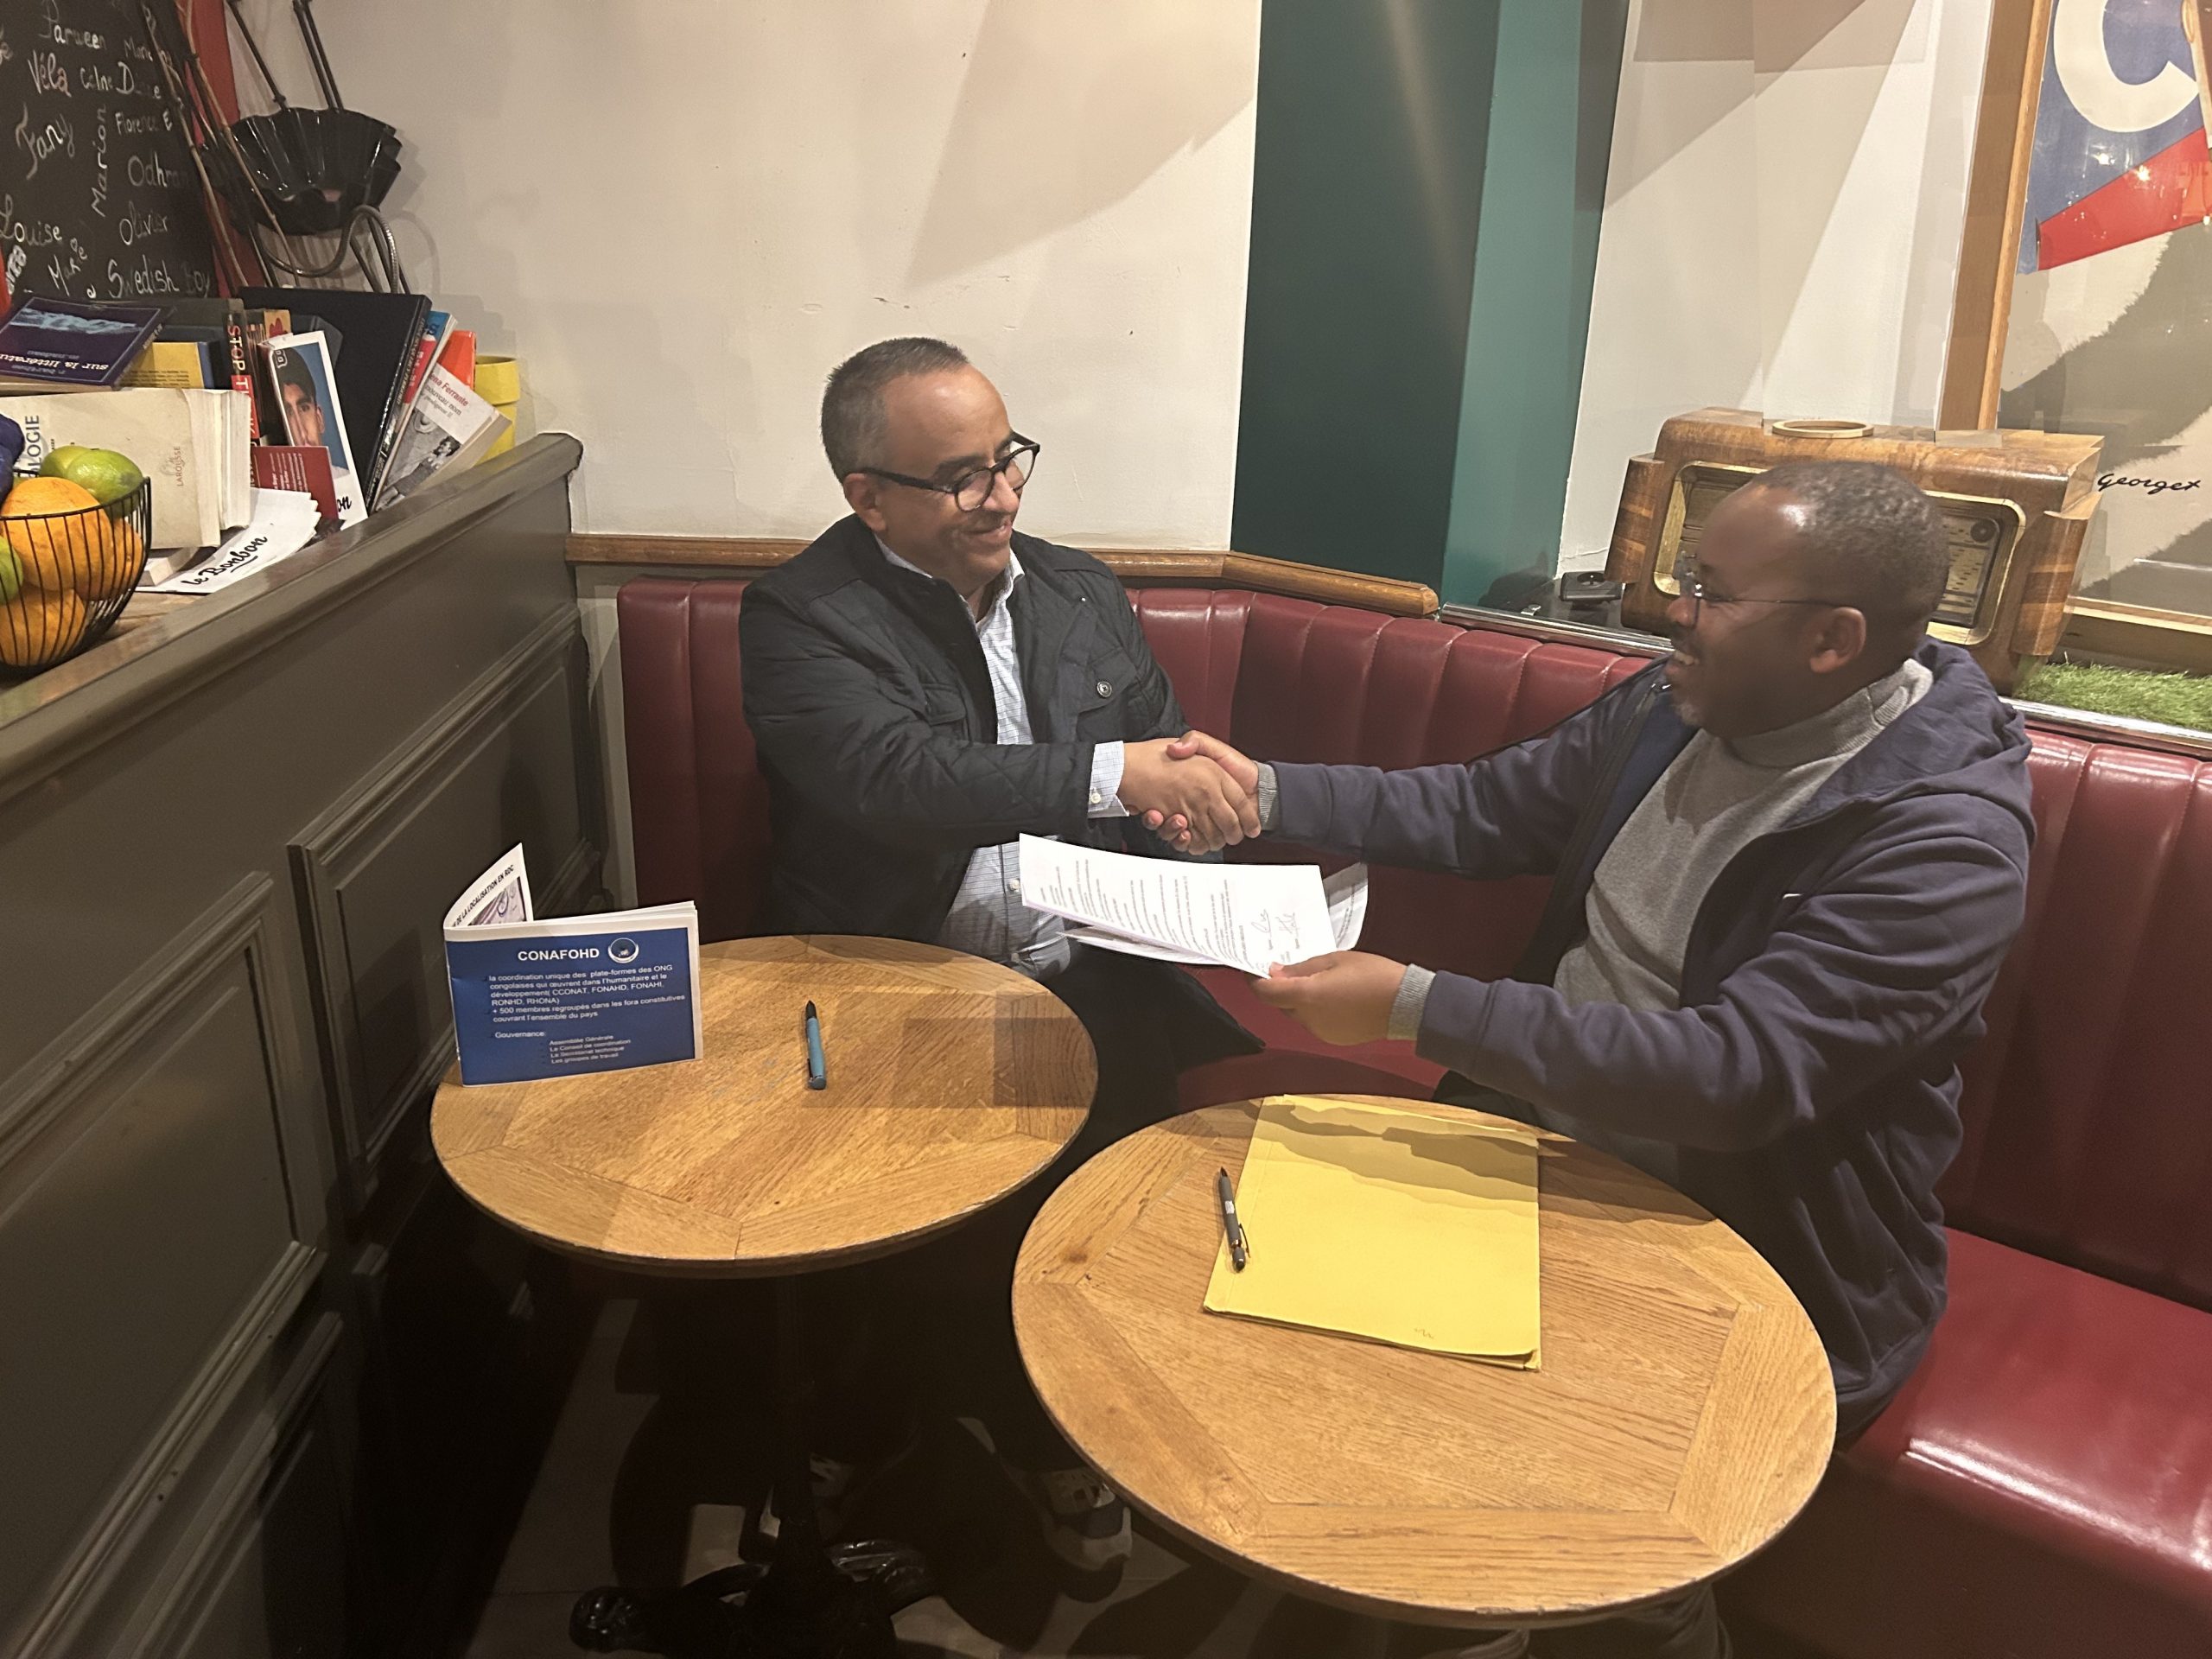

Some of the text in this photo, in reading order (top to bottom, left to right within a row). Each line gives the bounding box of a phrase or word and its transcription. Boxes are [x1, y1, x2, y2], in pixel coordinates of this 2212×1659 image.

[0, 194, 63, 246] Louise
[108, 254, 180, 298] Swedish
[0, 353, 59, 368] littératu
[227, 325, 246, 372] STOP
[65, 361, 79, 370] la
[442, 382, 469, 406] Ferrante
[25, 416, 41, 472] LOGIE
[174, 446, 184, 486] LAROUSSE
[198, 537, 268, 575] Bonbon
[467, 879, 498, 912] LOCALISATION
[518, 948, 600, 961] CONAFOHD
[590, 968, 636, 978] plate-formes
[552, 1004, 590, 1013] regroupés
[640, 995, 685, 1004] constitutives
